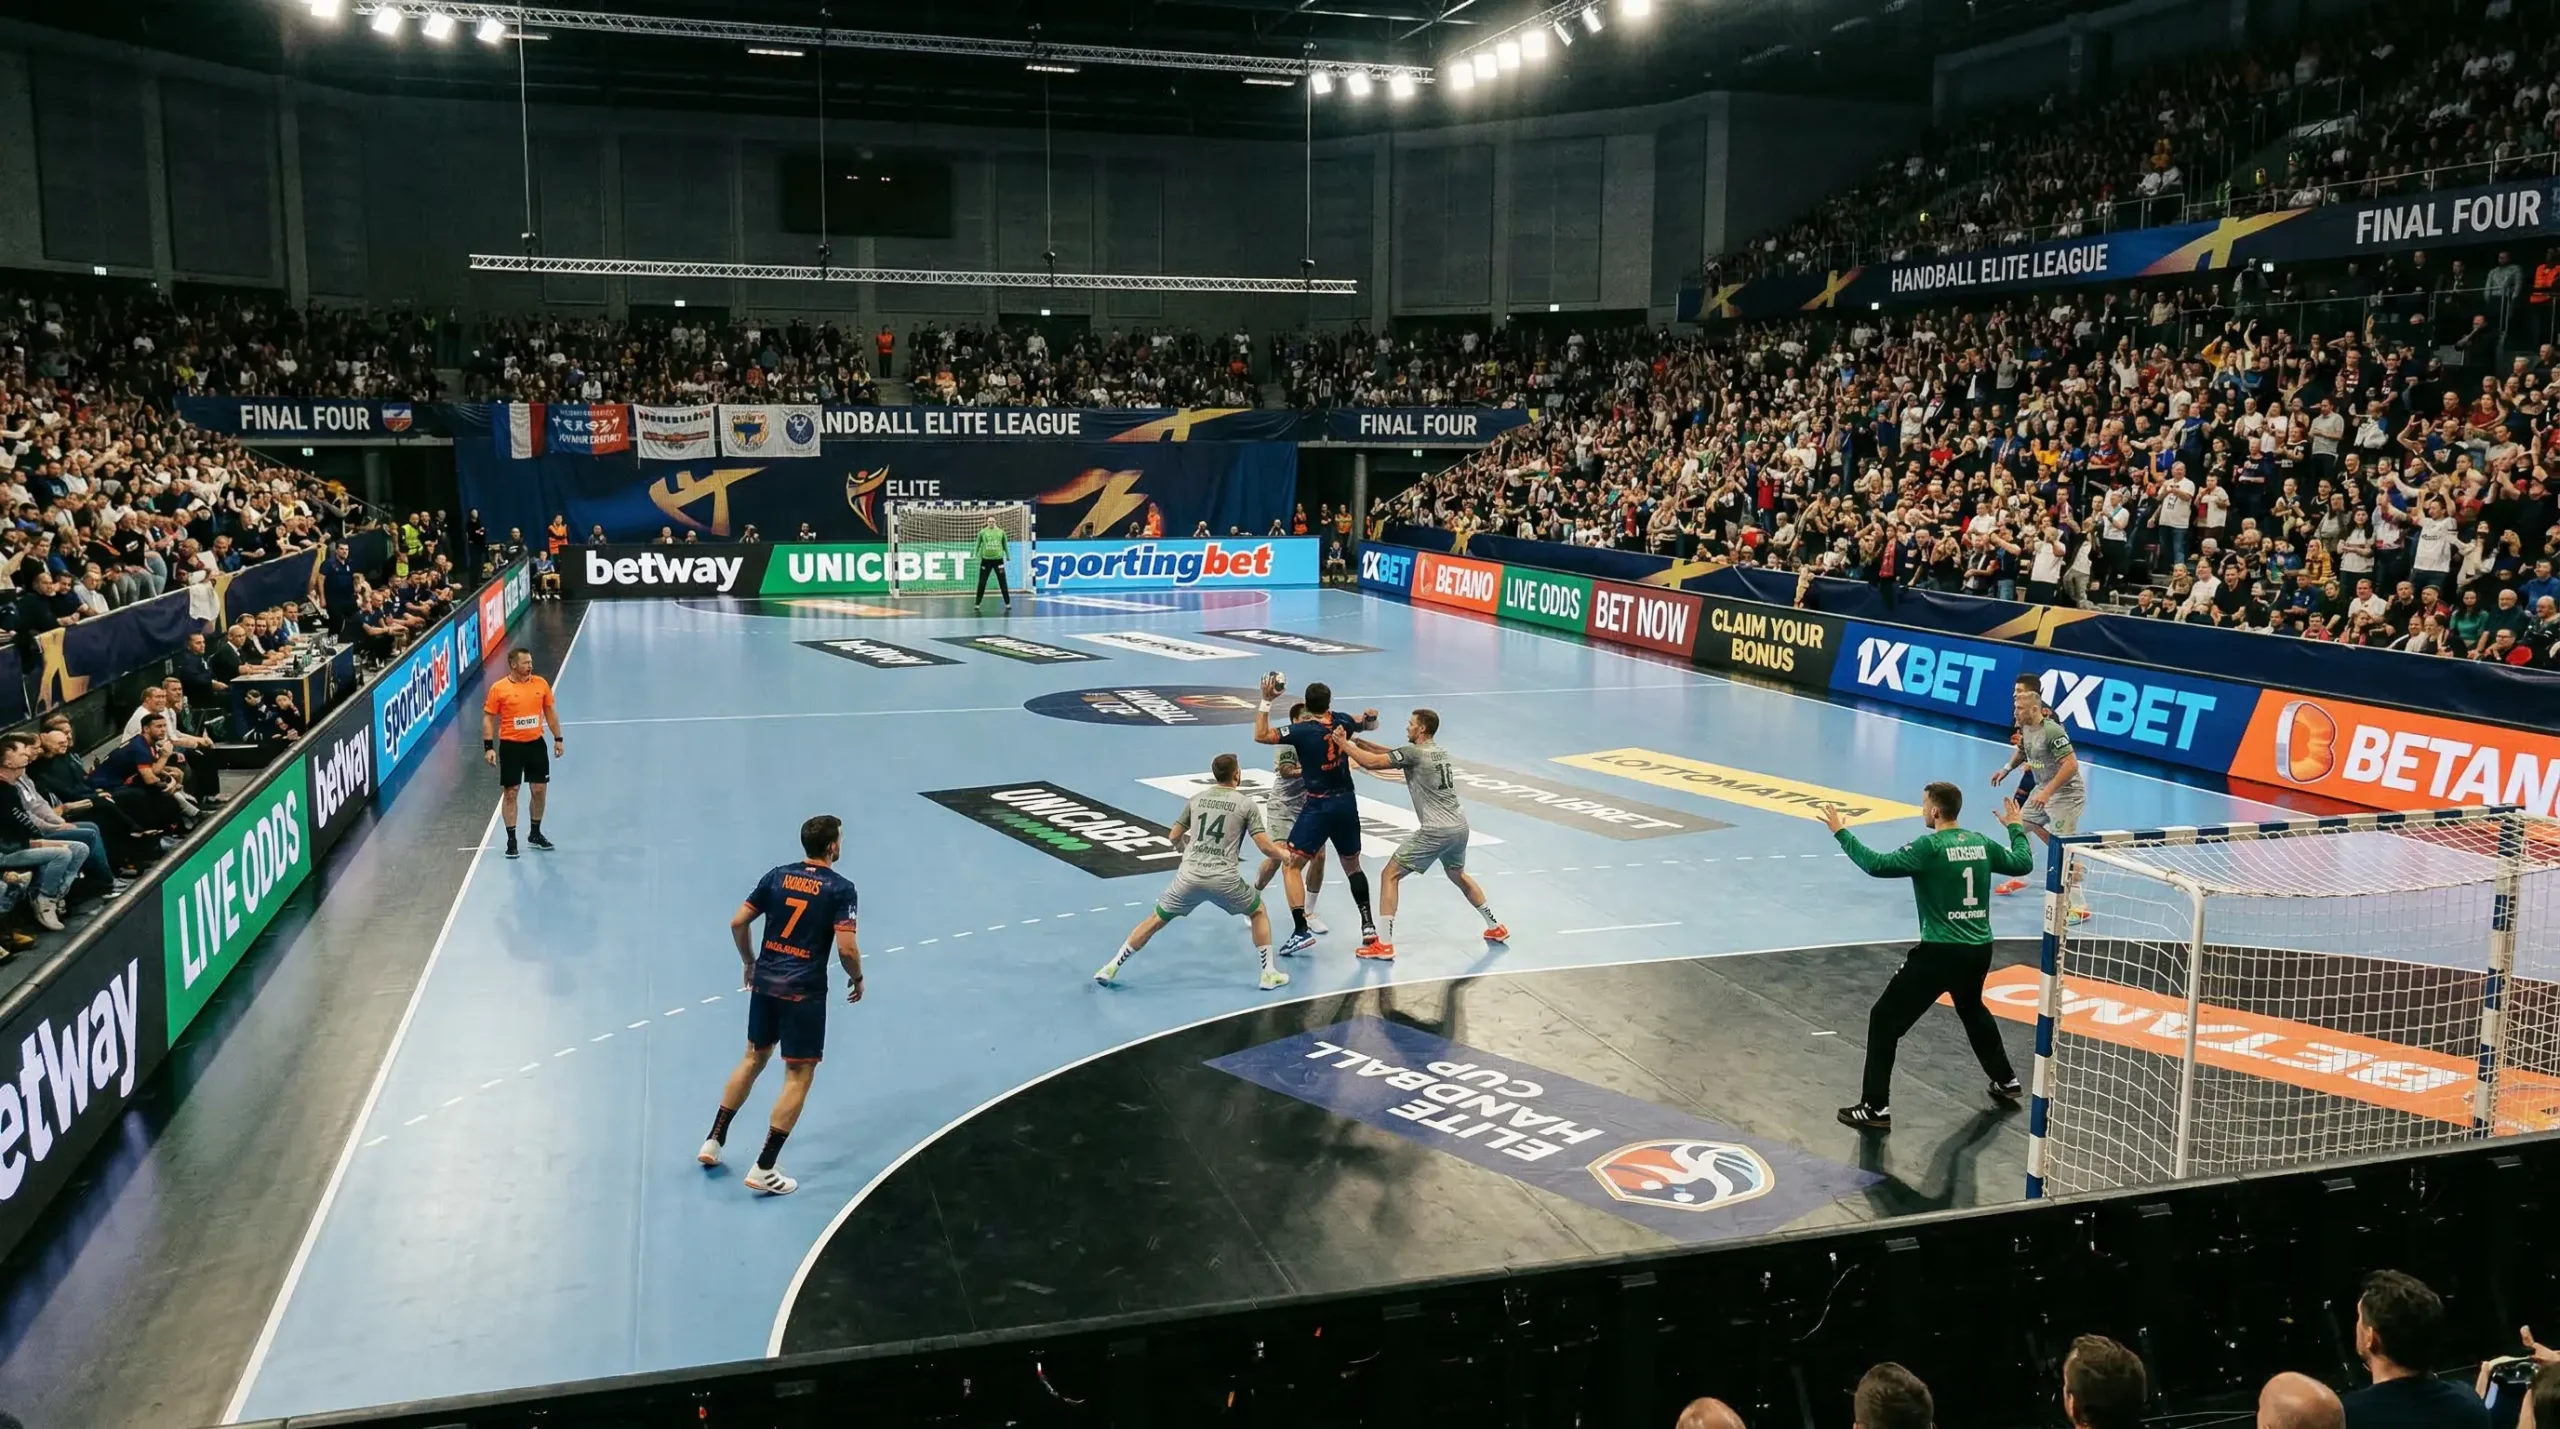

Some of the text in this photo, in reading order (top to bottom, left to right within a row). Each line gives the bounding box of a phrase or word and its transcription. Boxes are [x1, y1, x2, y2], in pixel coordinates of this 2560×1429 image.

[2356, 190, 2541, 245] FINAL FOUR
[1891, 243, 2109, 292] HANDBALL ELITE LEAGUE
[240, 405, 371, 431] FINAL FOUR
[820, 411, 1081, 435] NDBALL ELITE LEAGUE
[1360, 414, 1477, 435] FINAL FOUR
[885, 480, 940, 497] ELITE
[586, 550, 744, 592] betway
[1031, 543, 1274, 588] sportingbet
[1362, 550, 1410, 587] 1XBET
[1435, 563, 1494, 602] BETANO
[1506, 577, 1580, 620] LIVE ODDS
[1595, 590, 1690, 646] BET NOW
[1711, 608, 1825, 650] CLAIM YOUR
[1731, 637, 1795, 673] BONUS
[1857, 636, 1997, 707] 1XBET
[383, 635, 450, 763] sportingbet
[314, 724, 369, 829] betway
[1592, 754, 1874, 818] LOTTOMATICA
[2343, 724, 2560, 817] BETAN
[1197, 812, 1226, 844] 14
[178, 788, 301, 990] LIVE ODDS
[1962, 867, 1978, 906] 1
[781, 897, 808, 939] 7
[1980, 983, 2477, 1094] BETANO
[1304, 1040, 1606, 1145] HANDBALL
[1426, 1061, 1544, 1098] CUP
[1385, 1098, 1564, 1162] ELITE
